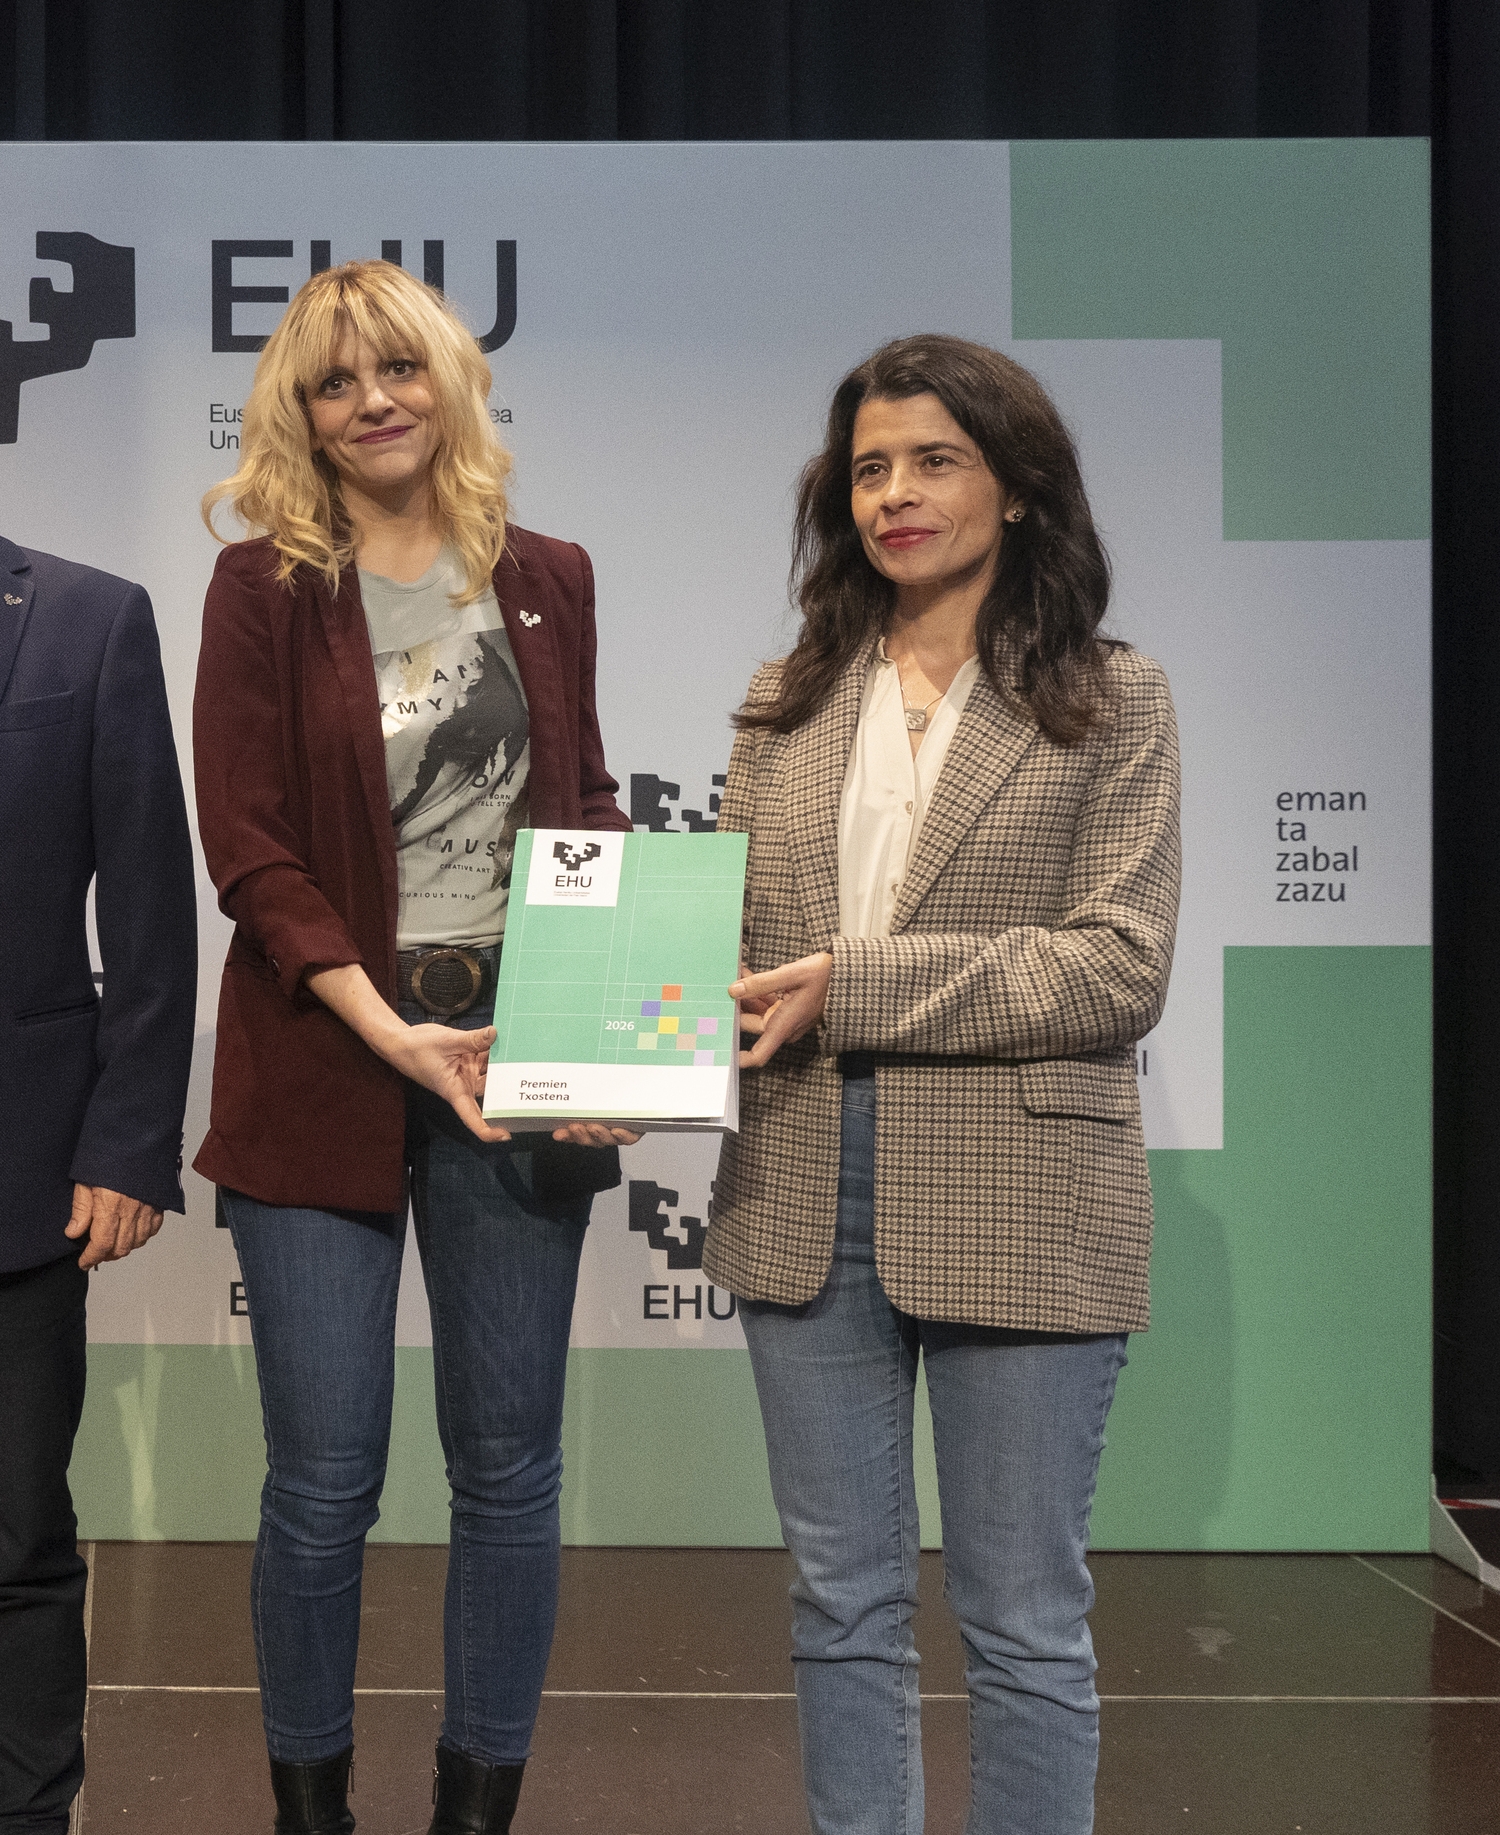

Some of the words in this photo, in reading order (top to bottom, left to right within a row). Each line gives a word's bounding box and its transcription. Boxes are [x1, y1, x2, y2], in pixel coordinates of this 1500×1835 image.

[1276, 791, 1366, 812] eman
[1276, 817, 1306, 841] ta
[1276, 845, 1358, 872] zabal
[555, 875, 593, 888] EHU
[451, 893, 477, 901] MIND
[1276, 882, 1346, 902] zazu
[604, 1020, 636, 1031] 2026
[520, 1080, 568, 1089] Premien
[519, 1092, 571, 1102] Txostena
[643, 1284, 737, 1321] EHU
